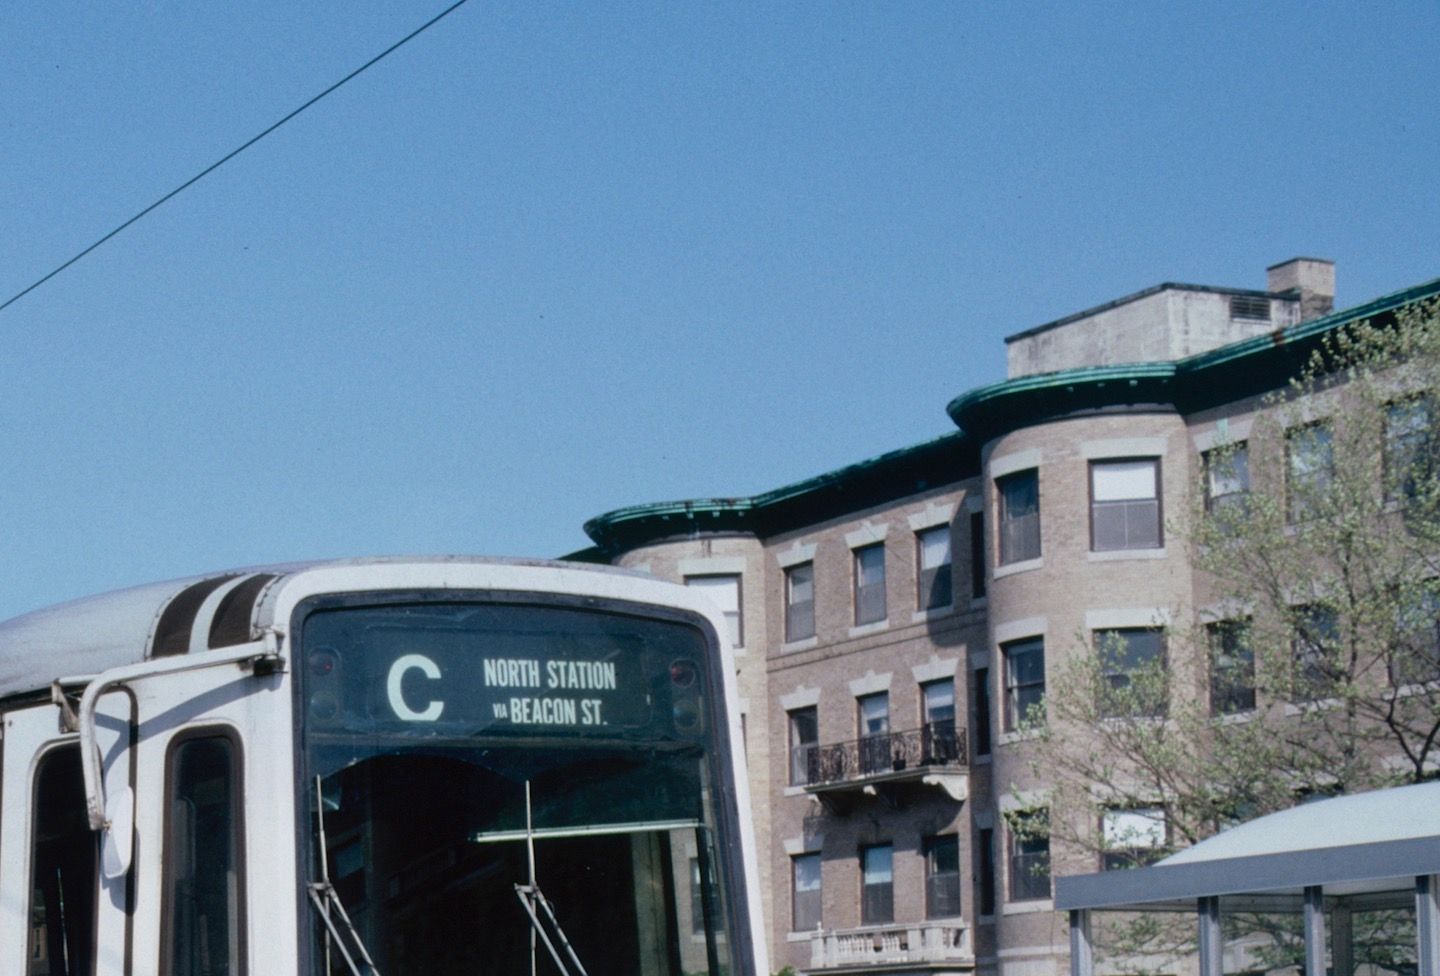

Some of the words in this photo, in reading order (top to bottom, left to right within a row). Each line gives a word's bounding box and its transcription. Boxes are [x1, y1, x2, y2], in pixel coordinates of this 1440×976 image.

[386, 654, 445, 721] C
[483, 658, 540, 689] NORTH
[546, 660, 617, 691] STATION
[492, 702, 508, 719] VIA
[510, 697, 577, 725] BEACON
[580, 699, 610, 726] ST.
